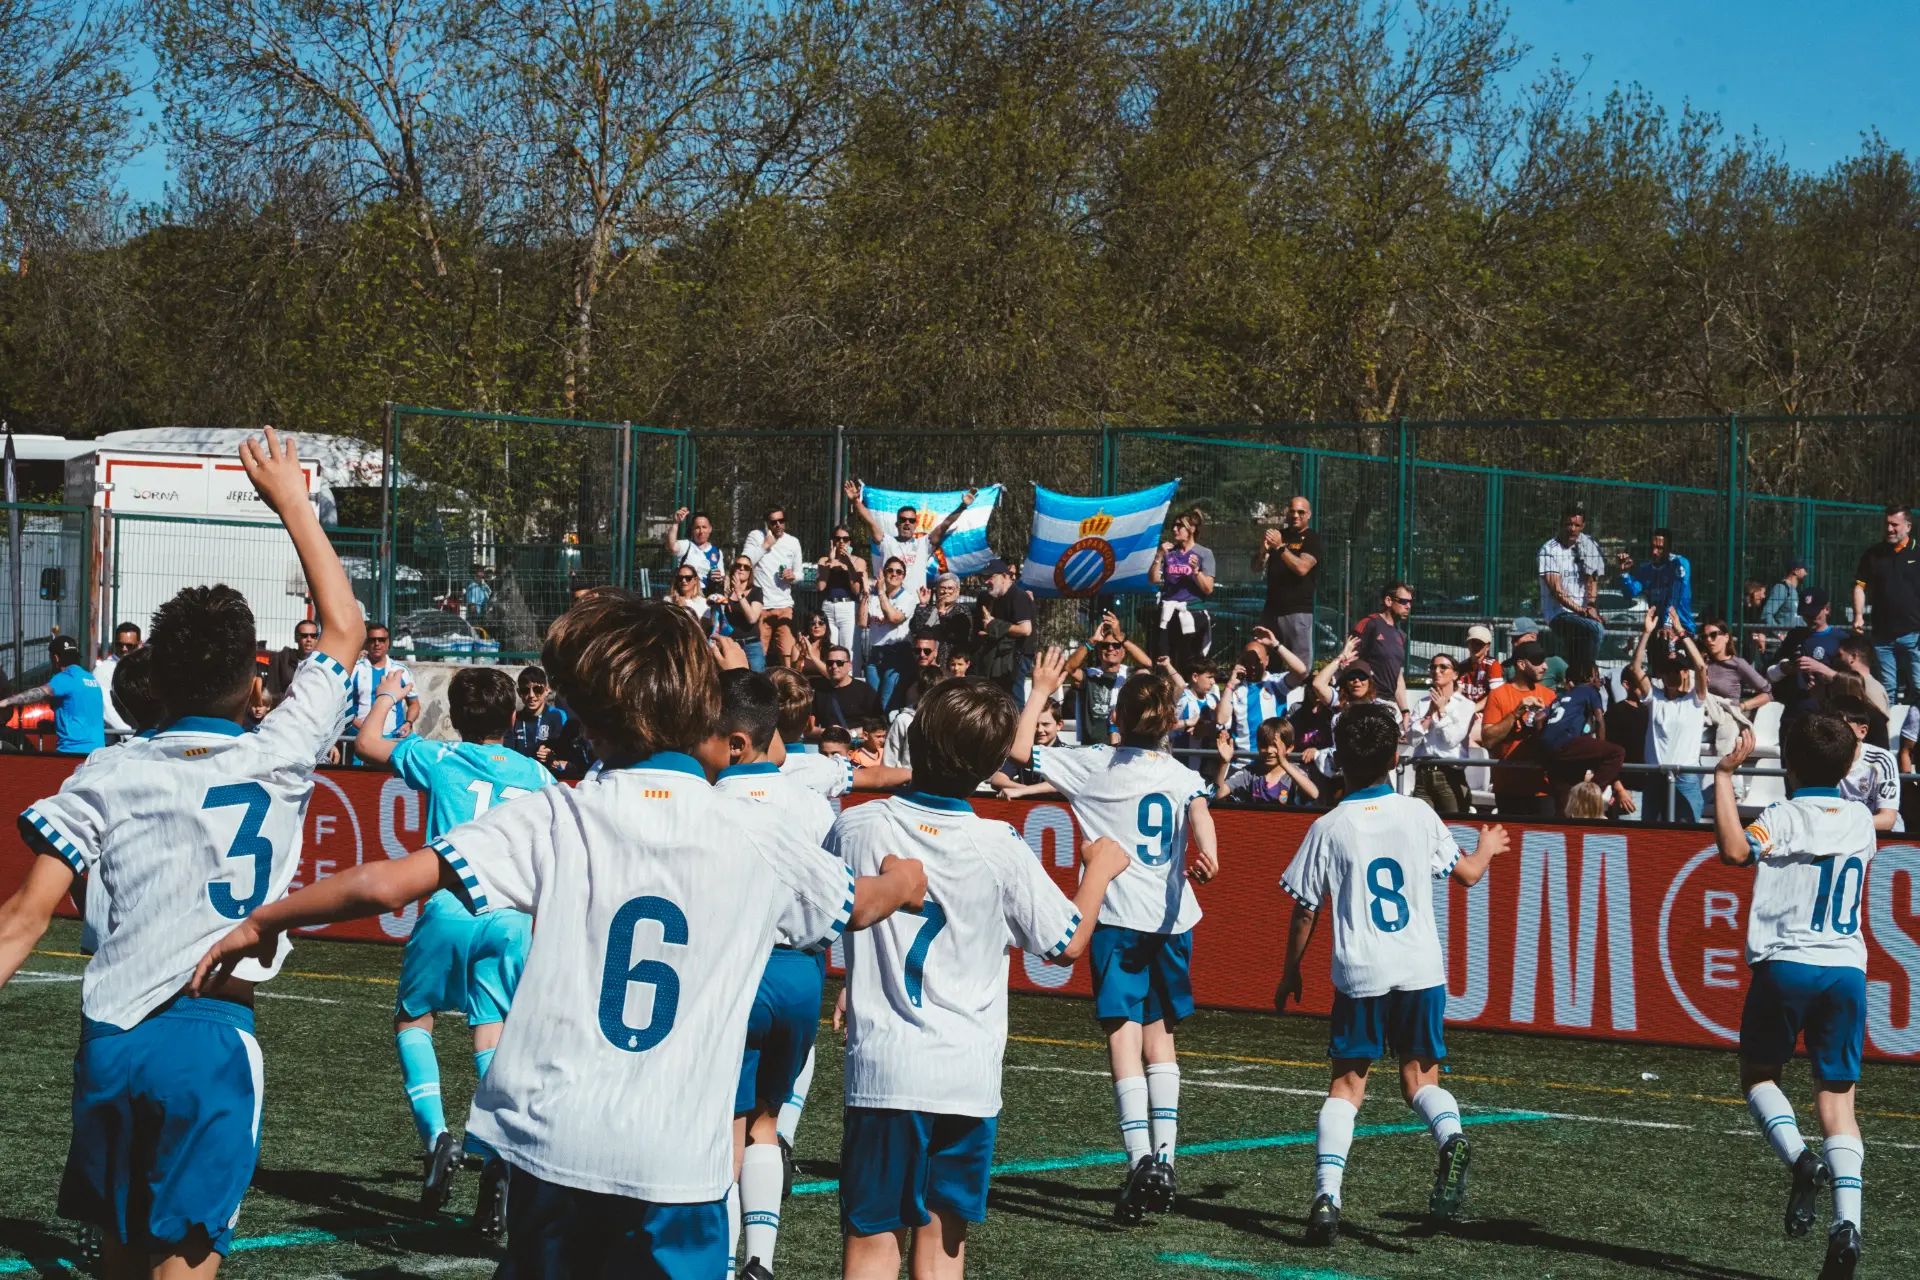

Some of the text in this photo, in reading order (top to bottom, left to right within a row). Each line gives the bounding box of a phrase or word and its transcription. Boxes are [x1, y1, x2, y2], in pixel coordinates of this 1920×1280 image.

[227, 490, 253, 502] JEREZ
[202, 782, 273, 920] 3
[1136, 793, 1173, 867] 9
[1366, 857, 1410, 933] 8
[1810, 855, 1863, 935] 10
[598, 896, 689, 1053] 6
[896, 900, 947, 1008] 7
